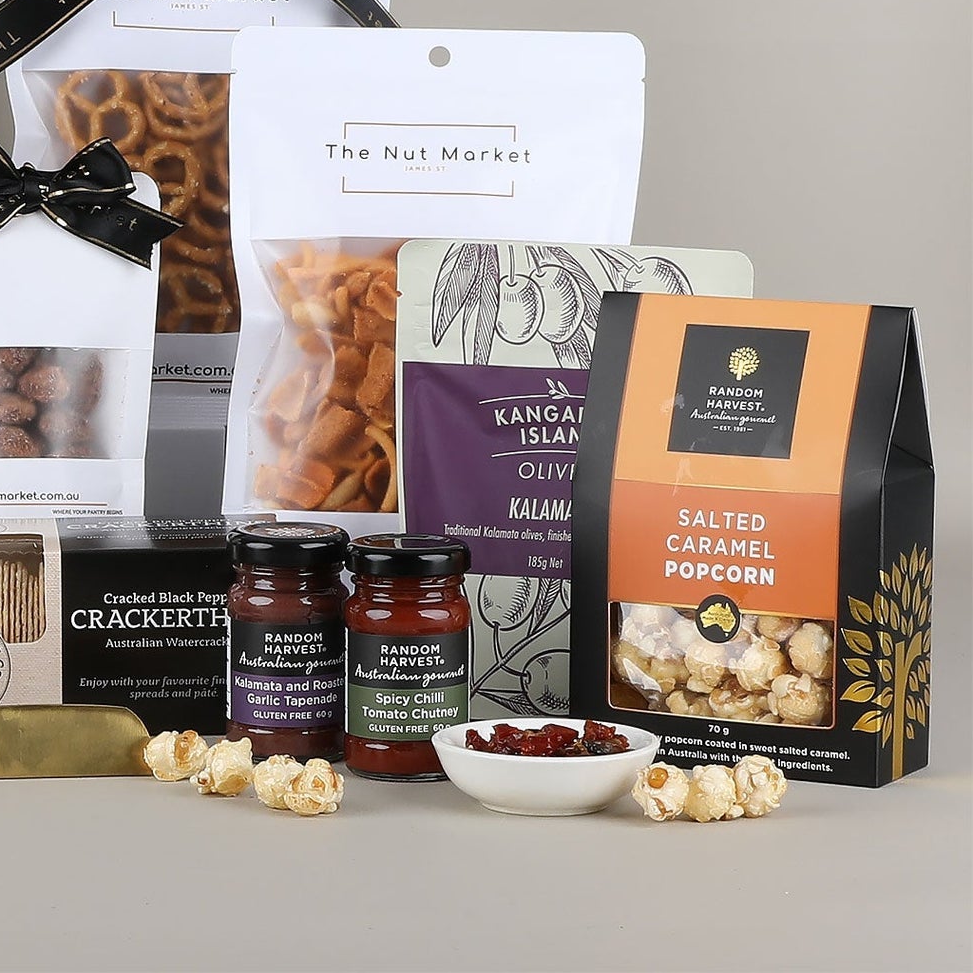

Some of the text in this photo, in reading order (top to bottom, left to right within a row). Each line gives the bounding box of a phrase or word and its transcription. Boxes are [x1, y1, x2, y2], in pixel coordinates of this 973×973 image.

[325, 144, 530, 164] The Nut Market
[709, 386, 763, 398] RANDOM
[689, 408, 740, 422] Australian
[678, 508, 766, 532] SALTED
[443, 523, 481, 537] Traditional
[483, 526, 519, 540] Kalamata
[521, 528, 546, 542] olives,
[666, 534, 775, 560] CARAMEL
[527, 555, 564, 571] 185g Net
[664, 560, 775, 586] POPCORN
[103, 592, 156, 605] Cracked
[159, 591, 195, 604] Black
[105, 638, 163, 648] Australian
[264, 633, 323, 643] RANDOM
[380, 644, 440, 654] RANDOM
[239, 651, 304, 669] Australian
[79, 675, 227, 689] Enjoy with your favourite fin
[355, 664, 465, 687] Australian gourmet
[234, 676, 283, 691] Kalamata
[286, 679, 309, 691] and
[129, 689, 170, 700] spreads
[172, 689, 191, 698] and
[247, 693, 338, 708] Garlic Tapenade
[375, 691, 445, 706] Spicy Chilli
[253, 711, 287, 720] GLUTEN
[289, 711, 312, 719] FREE
[316, 710, 326, 718] 60
[362, 705, 459, 721] Tomato Chutney
[368, 723, 444, 733] GLUTEN FREE 60
[708, 724, 729, 736] 70 g
[665, 735, 703, 746] popcorn
[705, 738, 736, 749] coated
[738, 741, 747, 750] in
[749, 744, 777, 753] sweet
[779, 746, 807, 756] salted
[809, 749, 851, 760] caramel.
[668, 748, 708, 760] Australia
[710, 752, 730, 762] with
[732, 754, 743, 763] th
[778, 759, 833, 772] ingredients.
